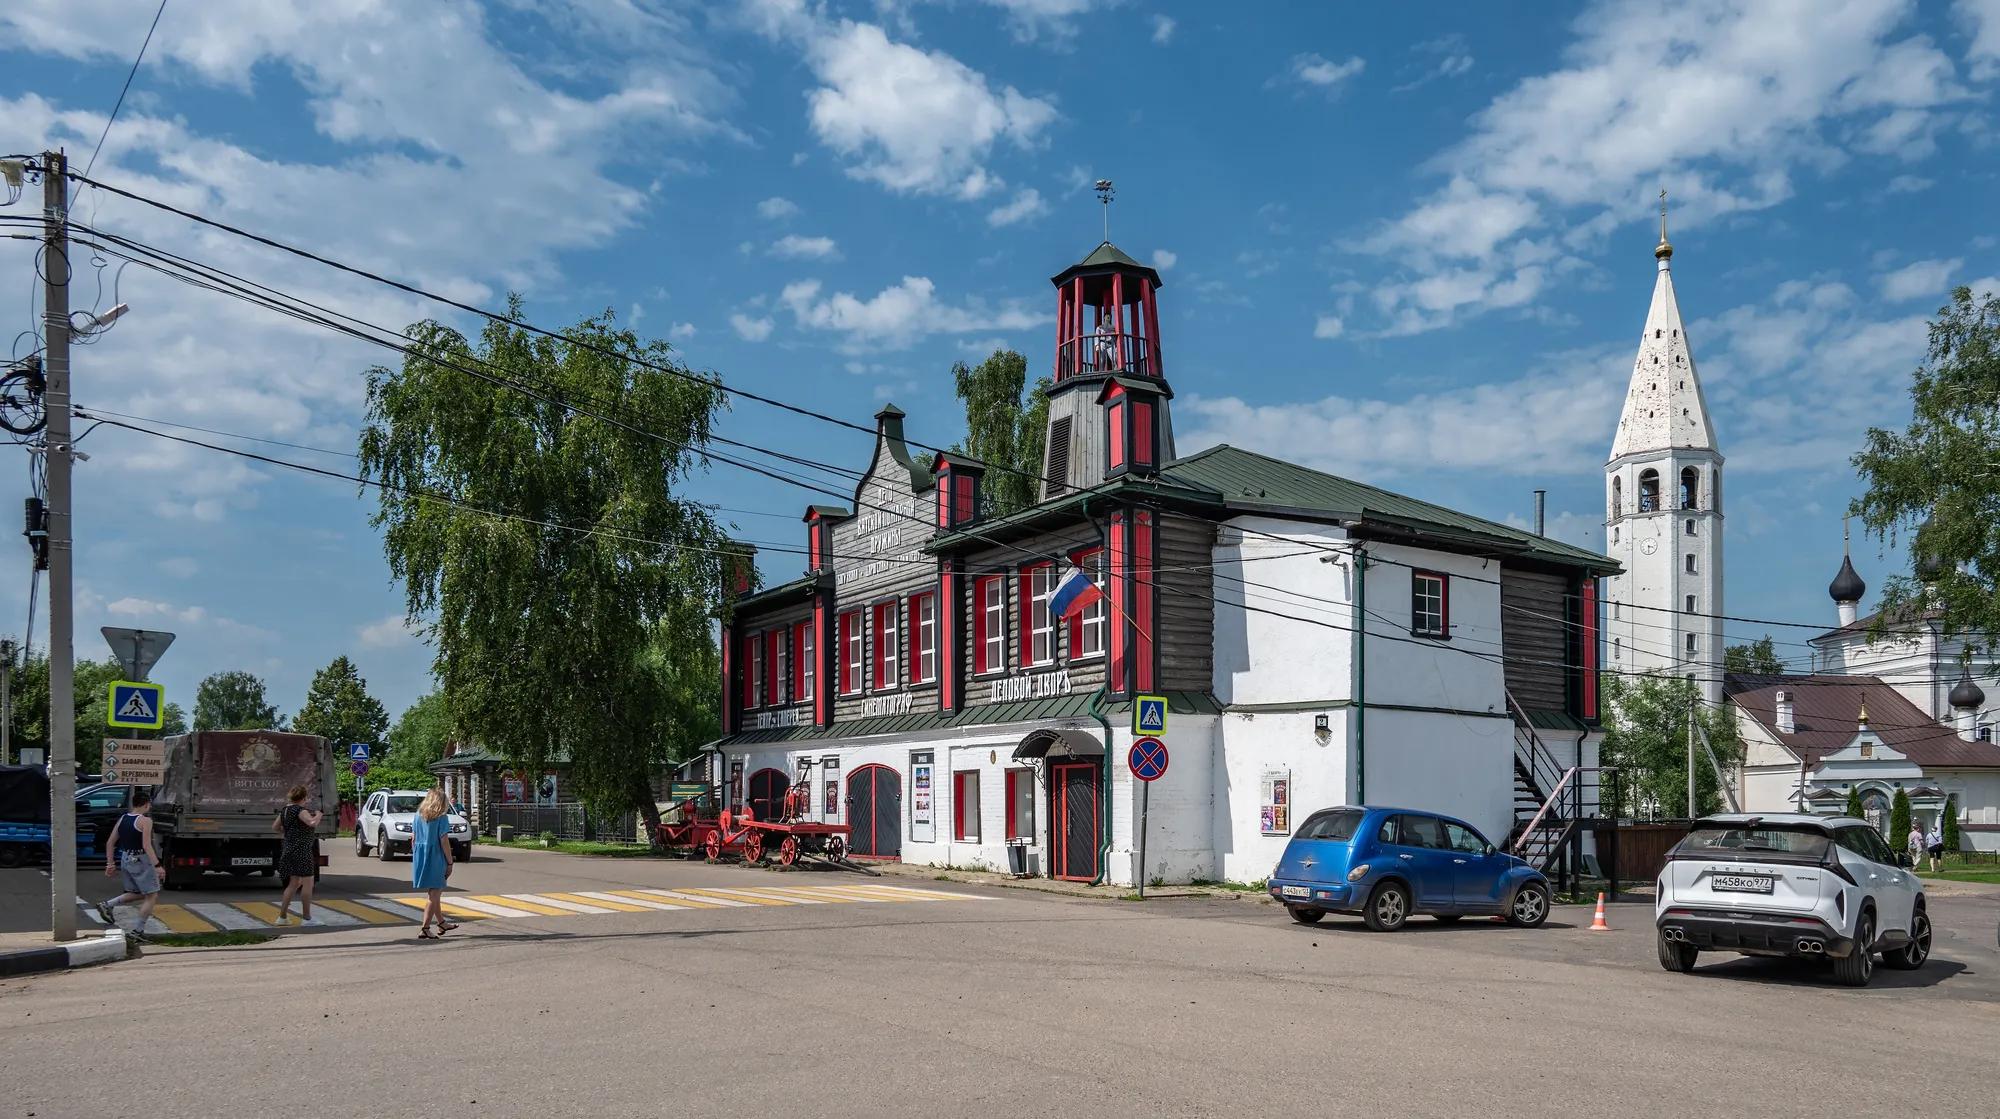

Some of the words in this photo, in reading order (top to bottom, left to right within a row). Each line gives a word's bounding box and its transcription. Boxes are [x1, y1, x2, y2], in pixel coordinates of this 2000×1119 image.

[870, 528, 901, 554] ДРУЖИНЫ
[991, 671, 1031, 704] ДЕЛОВОЙ
[1037, 670, 1072, 697] ДВОРЪ
[861, 692, 913, 718] СИНЕМАТОГРАФ
[1754, 878, 1770, 886] 977
